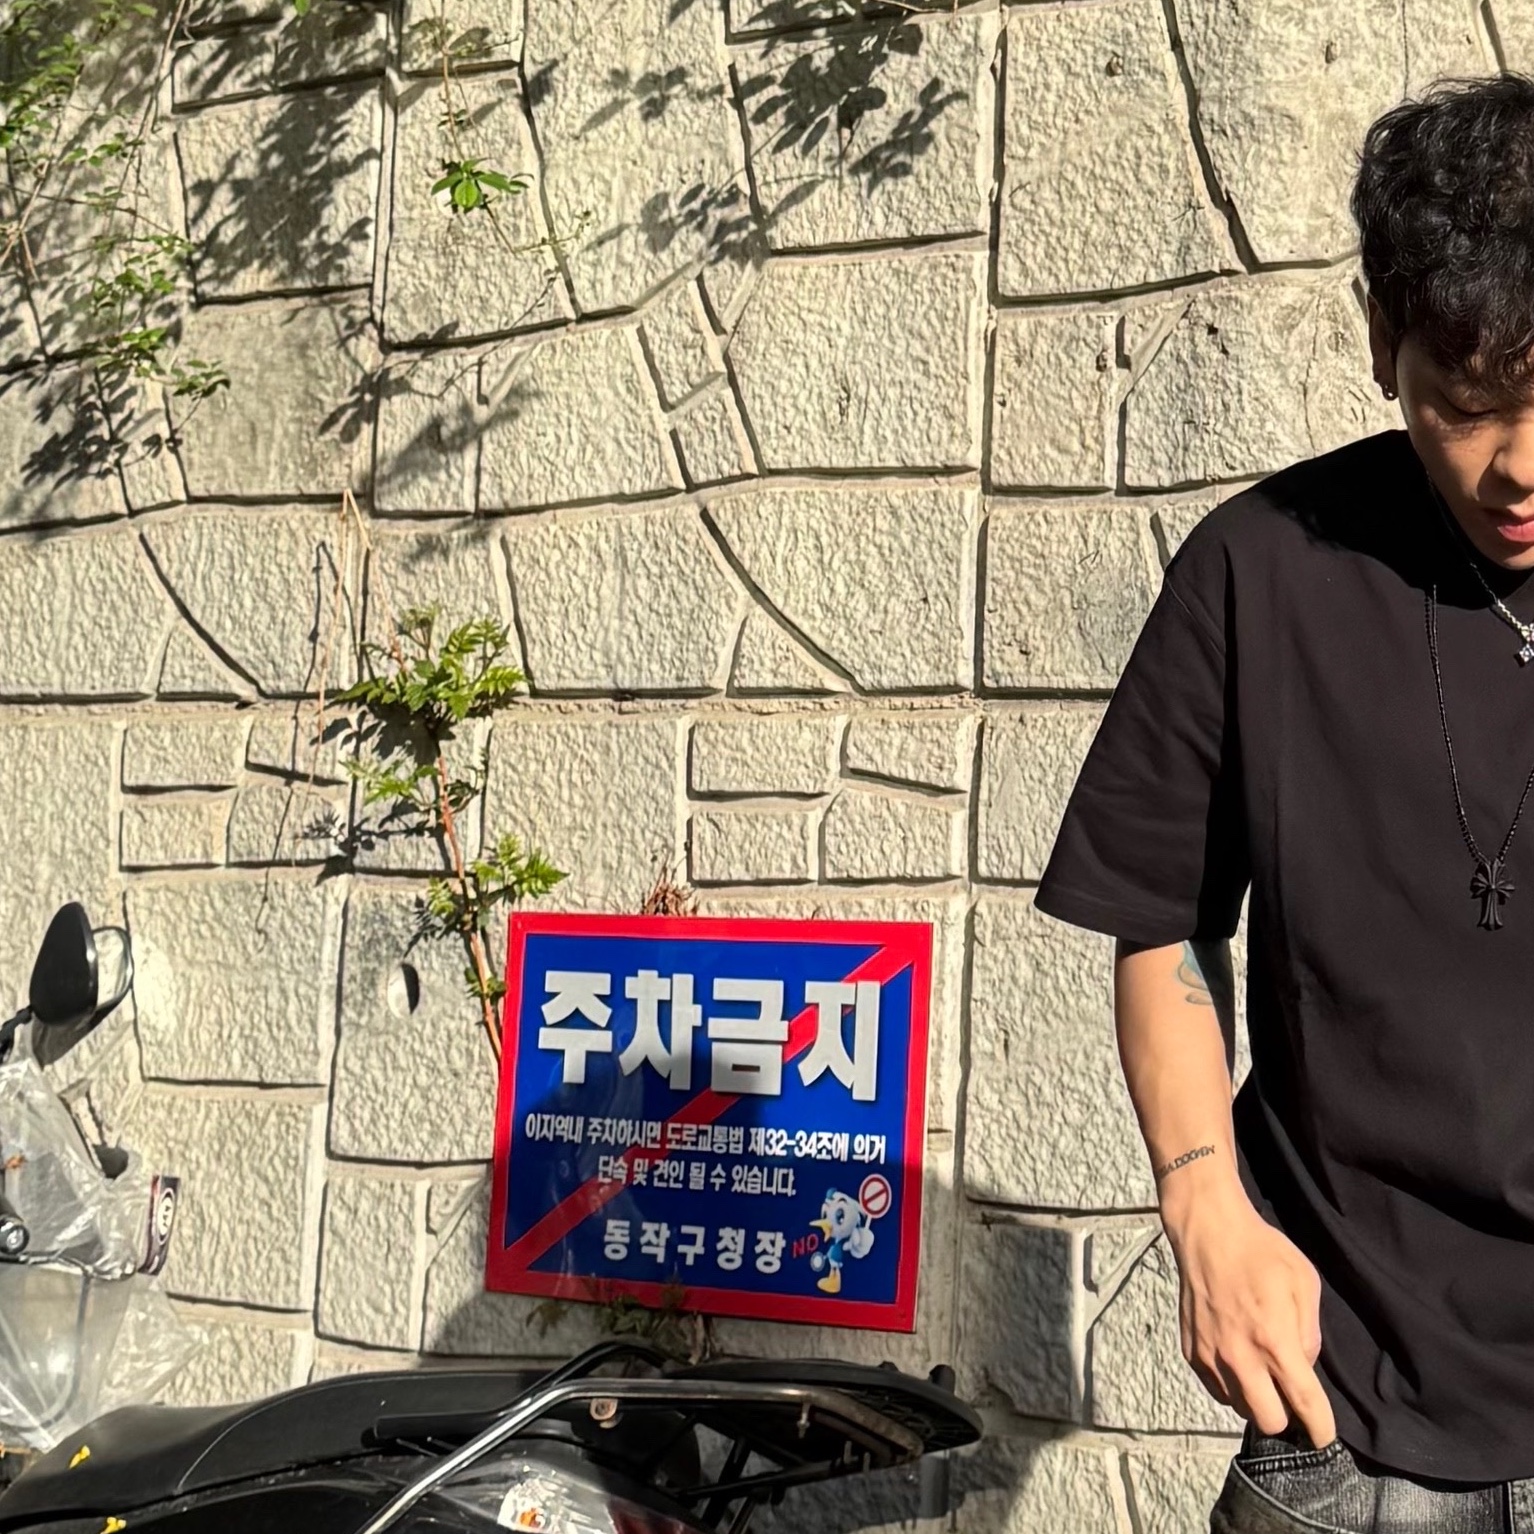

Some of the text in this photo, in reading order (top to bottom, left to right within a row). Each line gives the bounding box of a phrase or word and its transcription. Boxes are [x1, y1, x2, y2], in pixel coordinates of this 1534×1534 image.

[538, 969, 881, 1101] 주차금지
[525, 1113, 886, 1164] 이지역내 주차하시면 도로교통법 제32-34조에 의거
[597, 1155, 796, 1197] 단속 및 견인 될 수 있습니다.
[792, 1233, 818, 1258] NO
